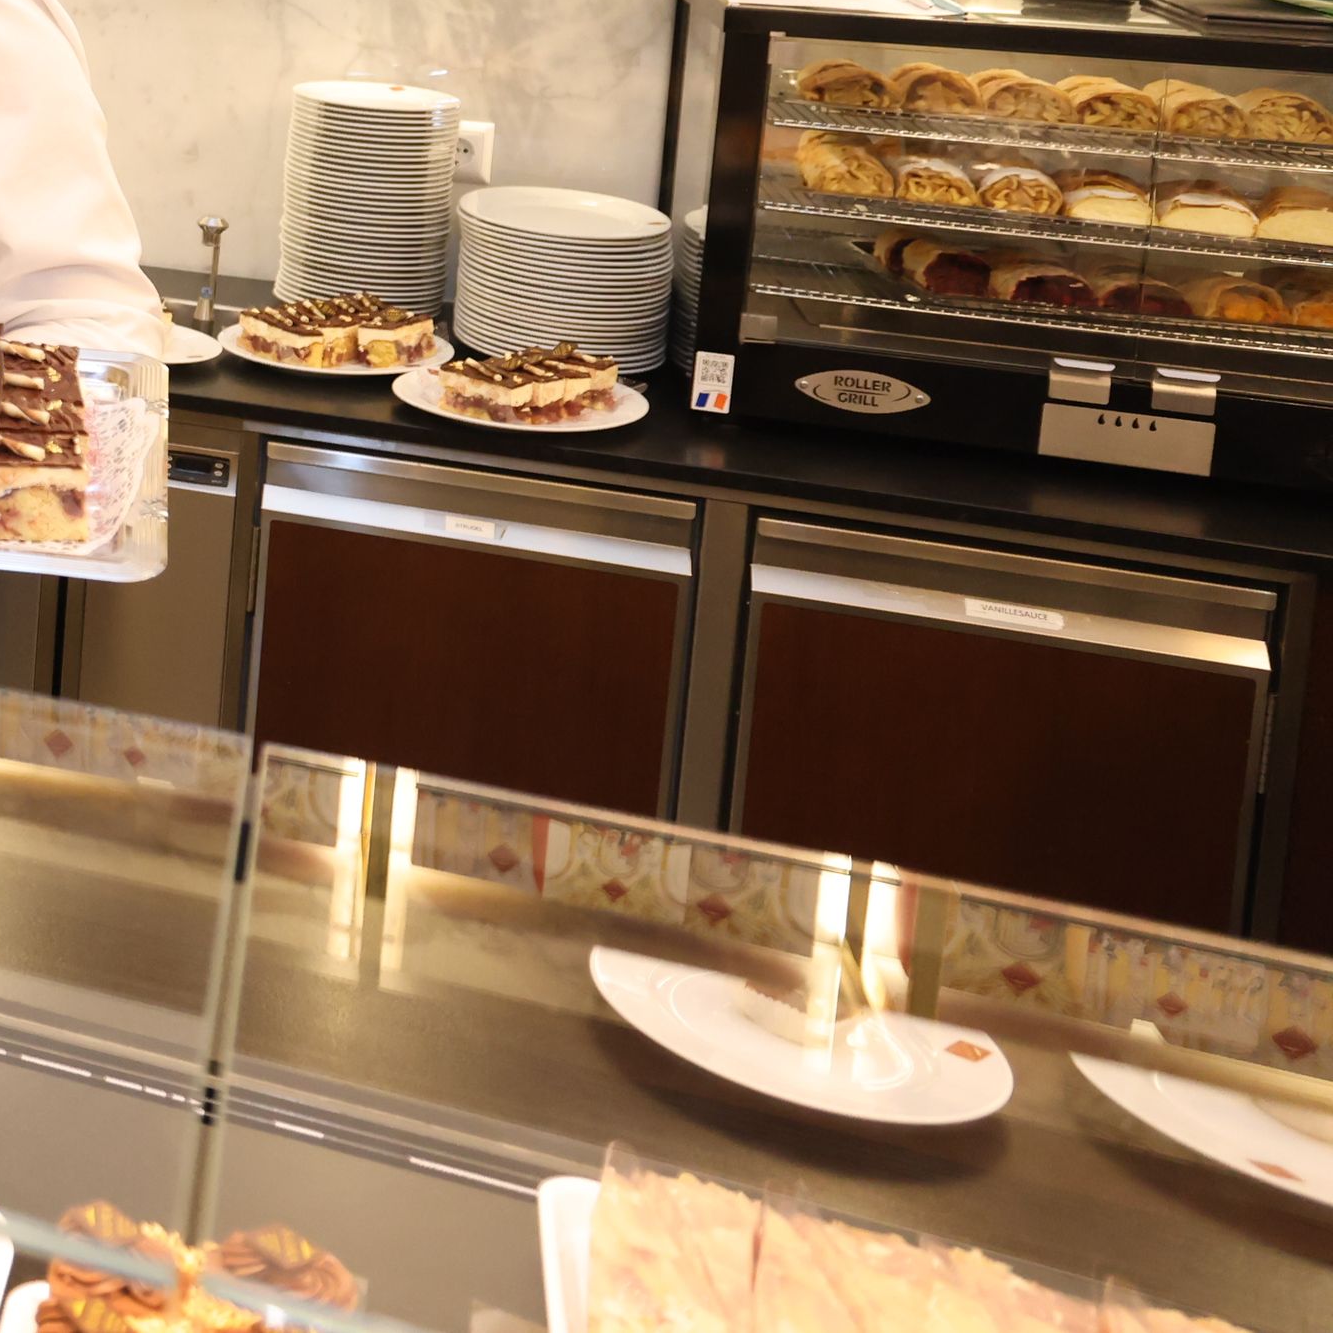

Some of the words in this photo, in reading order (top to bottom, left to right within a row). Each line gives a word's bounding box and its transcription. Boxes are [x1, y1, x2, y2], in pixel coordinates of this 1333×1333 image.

[833, 375, 892, 393] ROLLER
[837, 392, 879, 408] GRILL
[980, 604, 1049, 621] VANILLESAUCE
